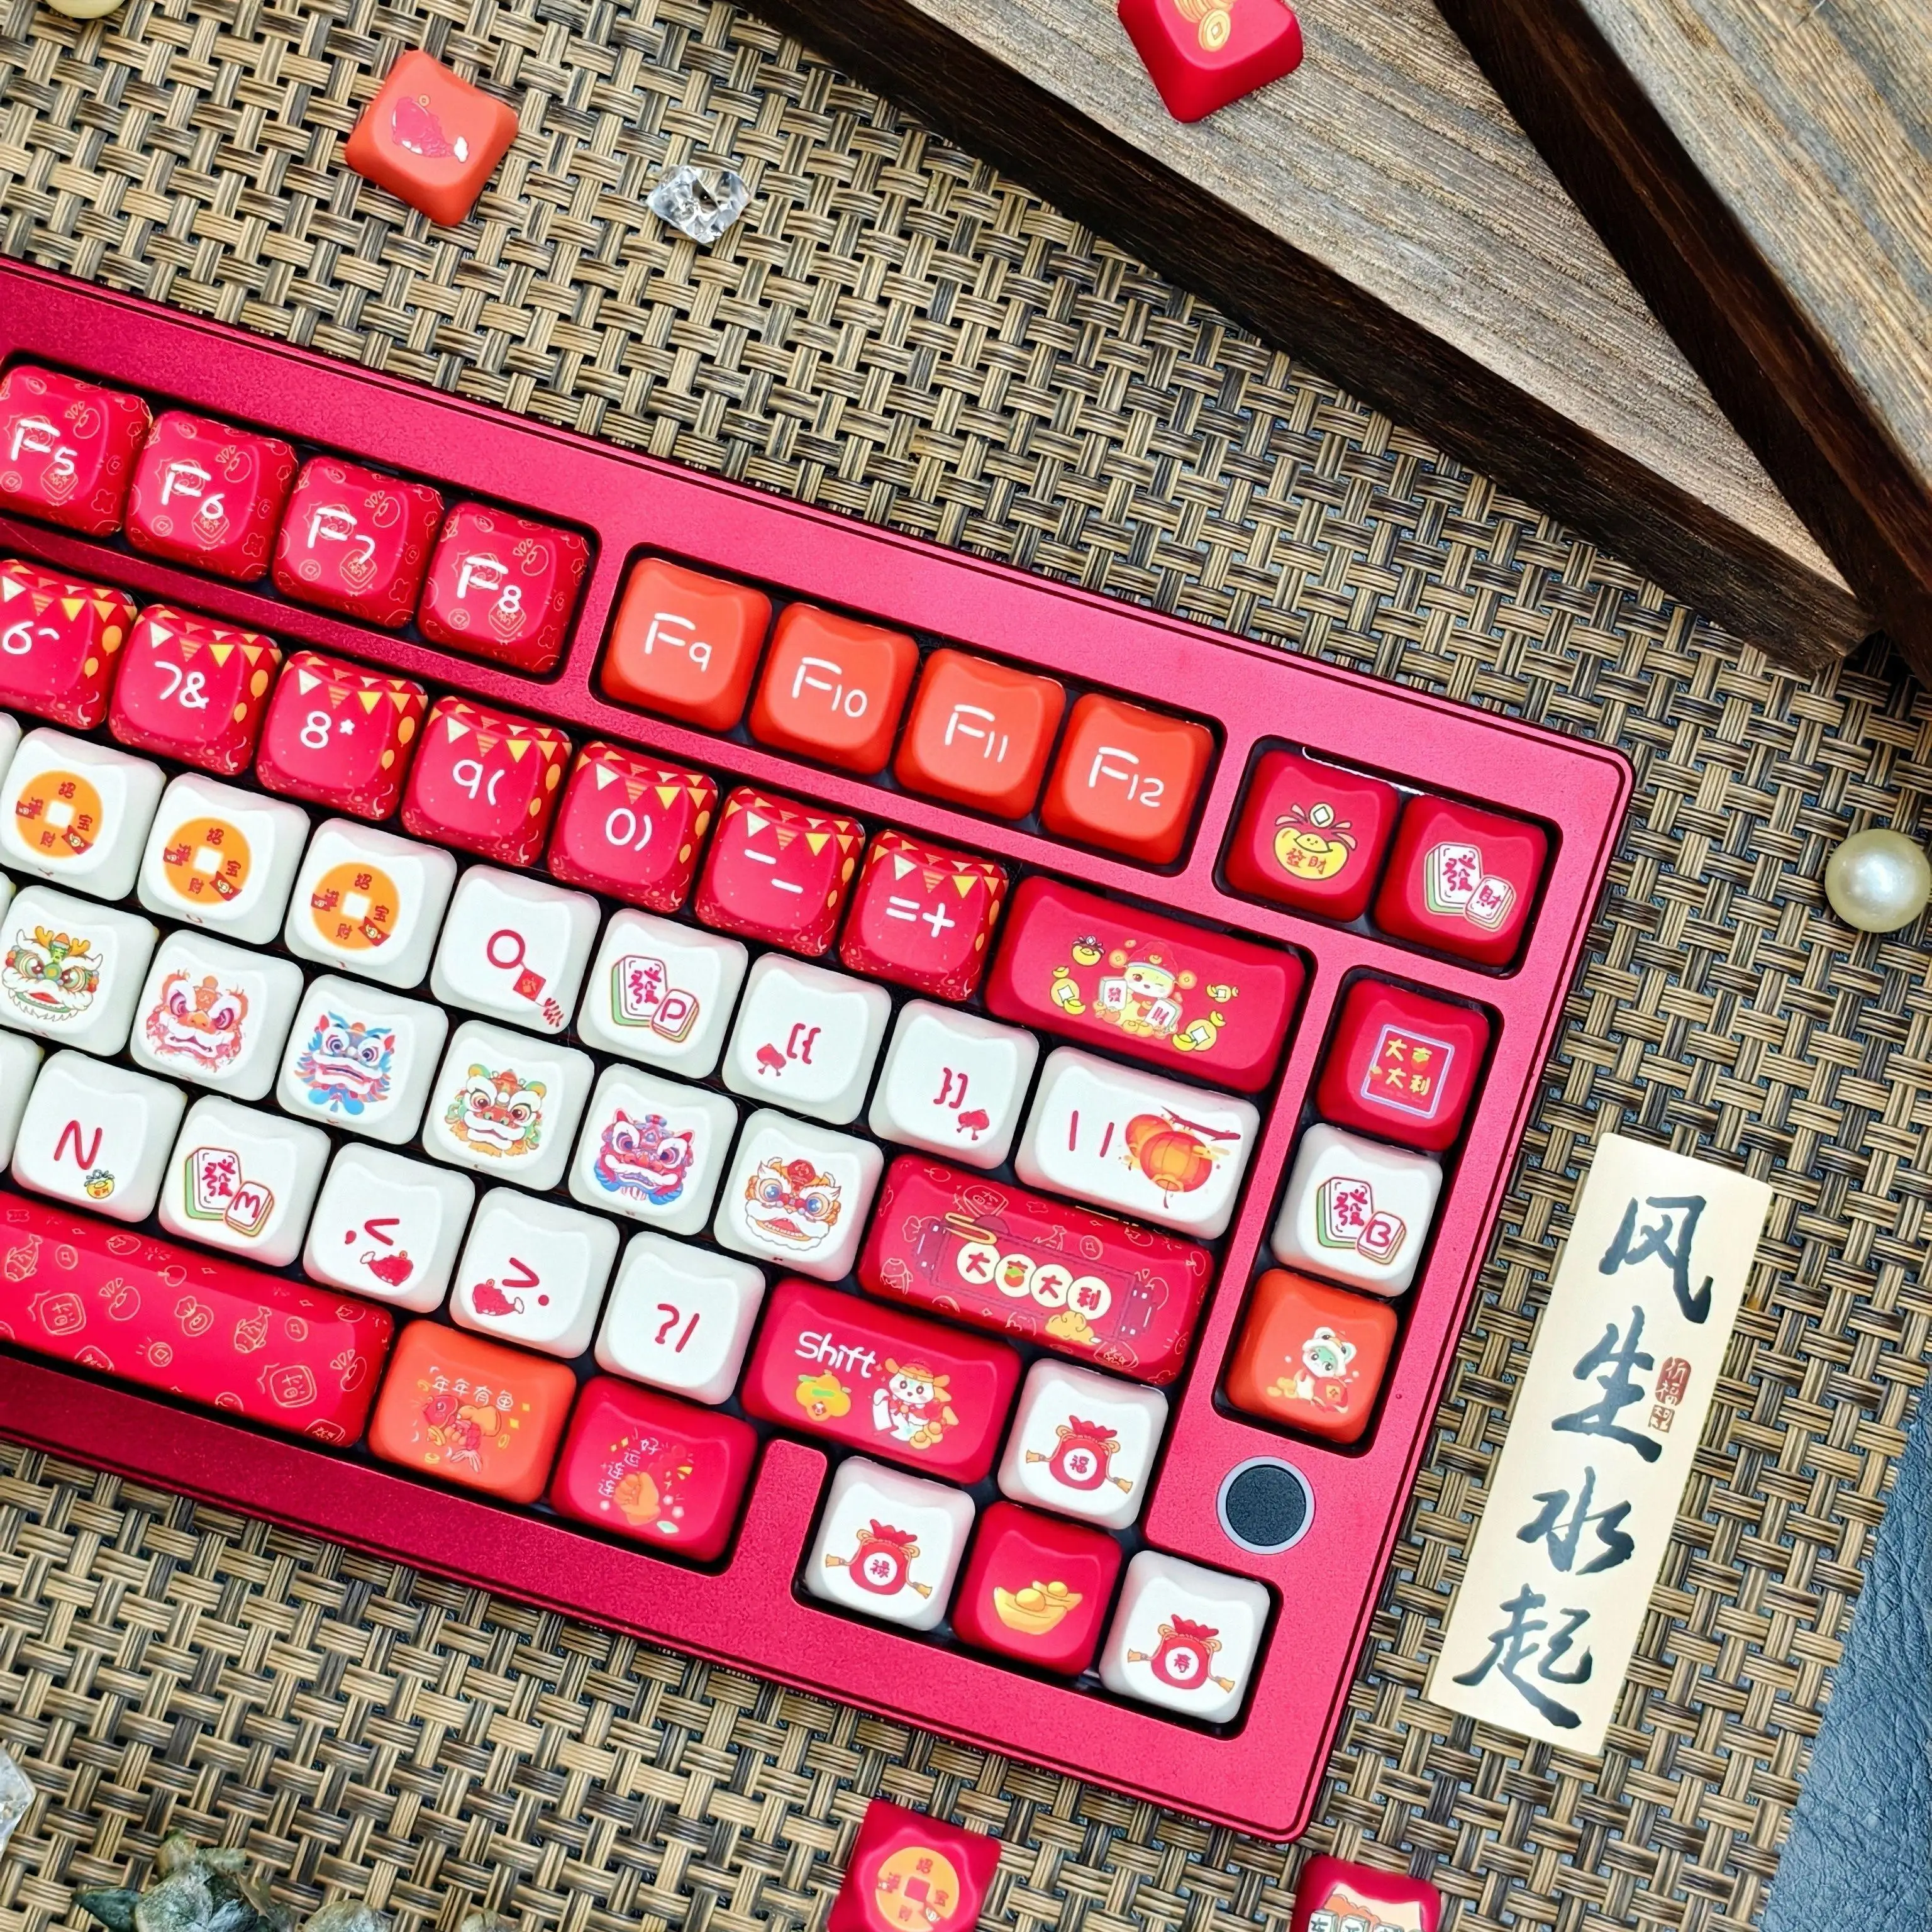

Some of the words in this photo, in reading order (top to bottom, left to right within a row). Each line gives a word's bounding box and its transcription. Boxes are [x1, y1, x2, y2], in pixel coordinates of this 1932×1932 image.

[11, 419, 78, 476] F5
[161, 464, 226, 519] F6
[307, 508, 375, 565] F7
[457, 557, 521, 613] F8
[645, 613, 713, 672] F9
[154, 660, 209, 710] 7&
[791, 657, 868, 718] F10
[945, 704, 1009, 763] F11
[1089, 747, 1165, 808] F12
[659, 998, 686, 1023] P
[1385, 1068, 1431, 1096] 大利
[53, 1120, 103, 1170] N
[1365, 1220, 1392, 1247] B
[795, 1331, 877, 1379] Shift
[431, 1374, 514, 1413] 年年有鱼
[1070, 1454, 1089, 1474] 福
[1453, 1194, 1714, 1730] 风生水起
